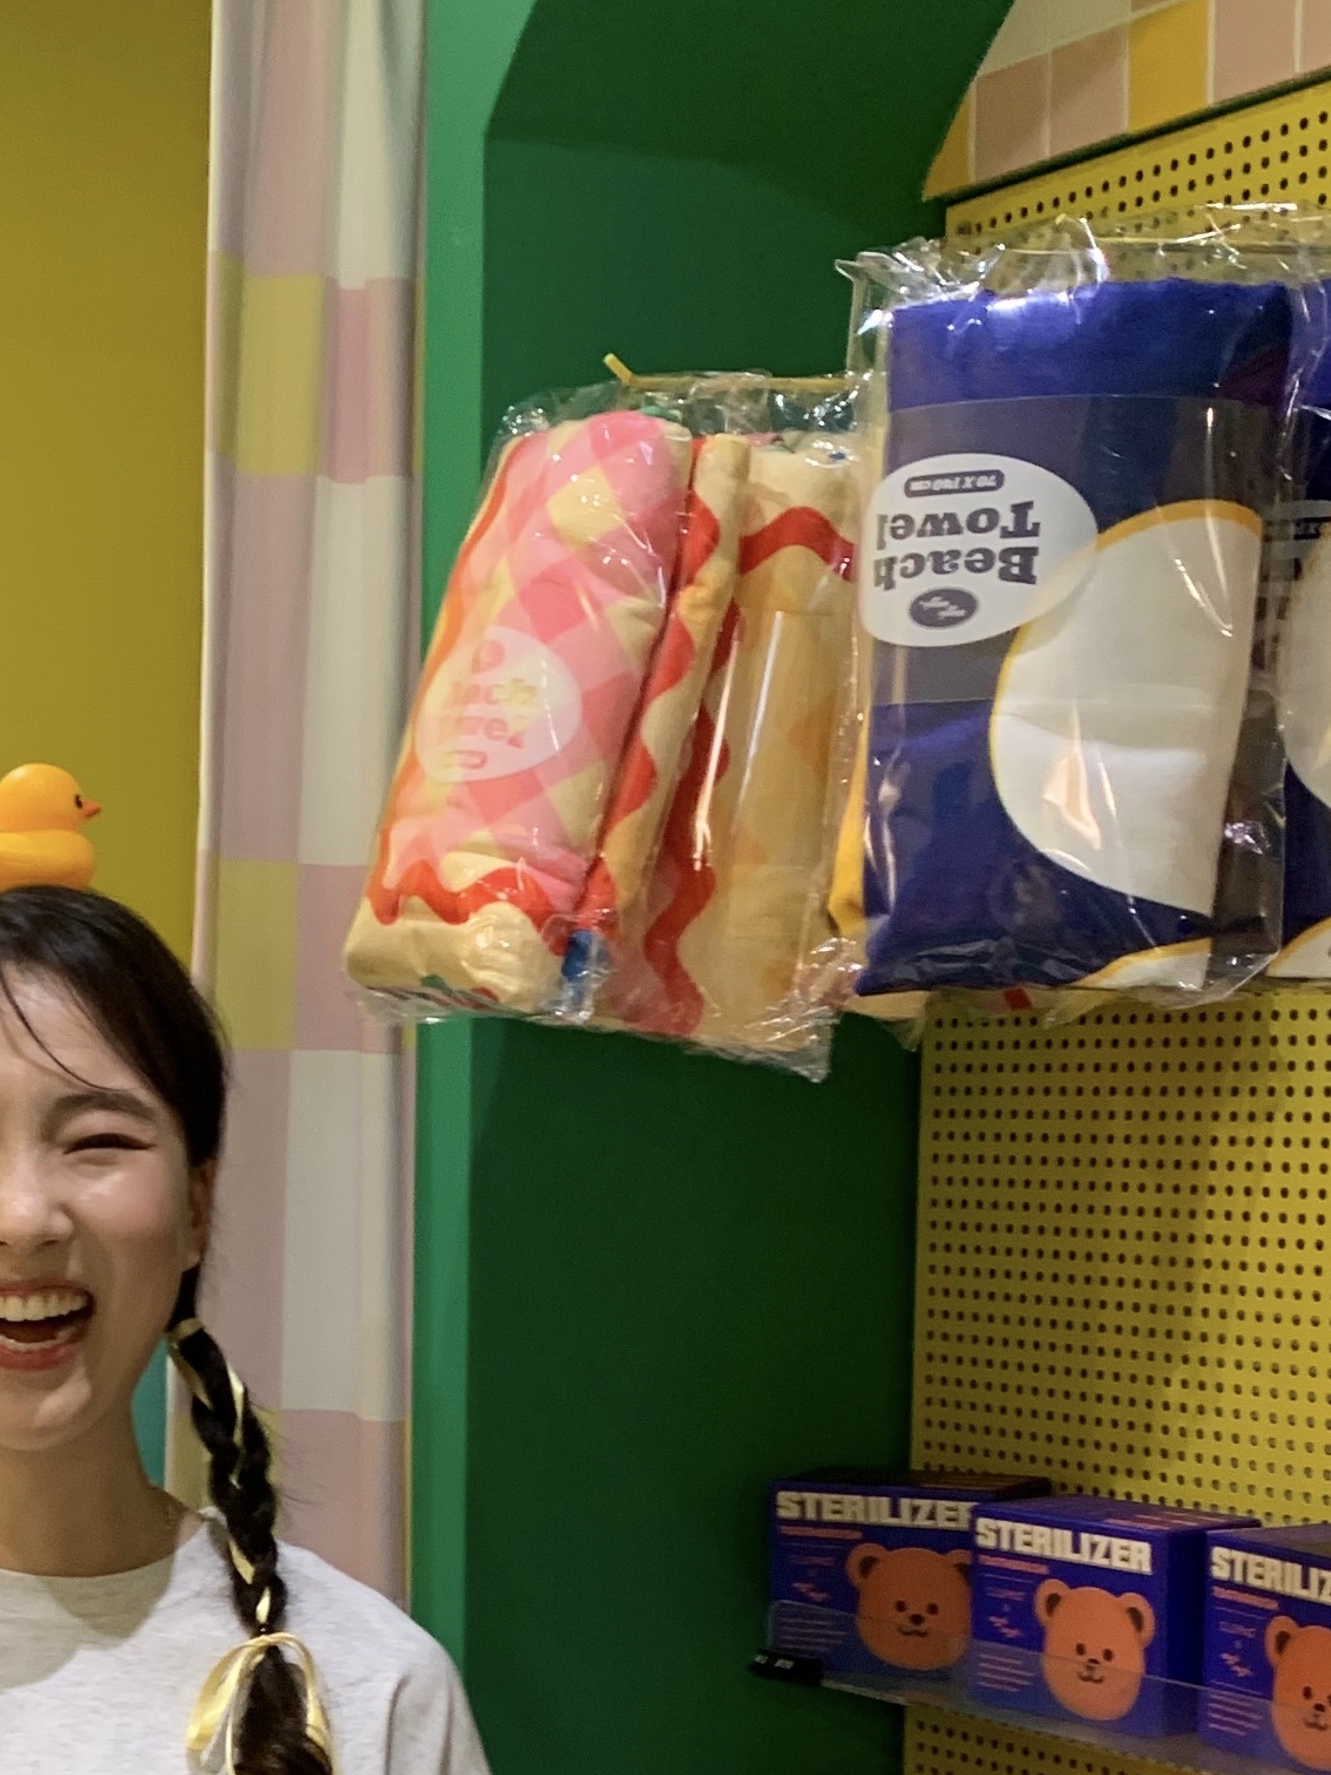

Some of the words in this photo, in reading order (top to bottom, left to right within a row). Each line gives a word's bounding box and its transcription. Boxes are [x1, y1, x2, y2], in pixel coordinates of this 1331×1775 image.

[876, 501, 1040, 550] Towel
[874, 547, 1039, 590] Beach
[976, 1517, 1152, 1575] STERILIZER
